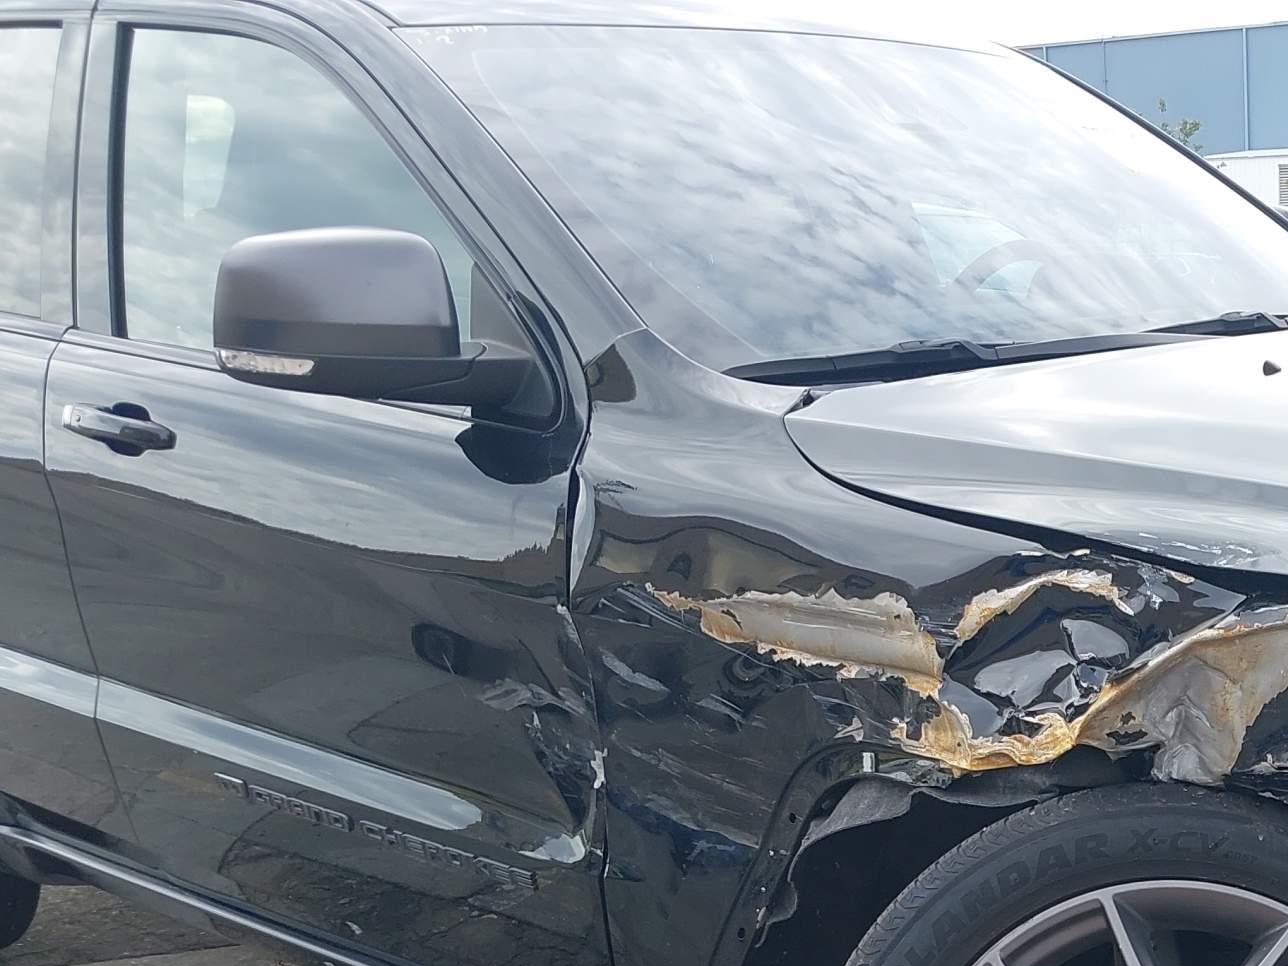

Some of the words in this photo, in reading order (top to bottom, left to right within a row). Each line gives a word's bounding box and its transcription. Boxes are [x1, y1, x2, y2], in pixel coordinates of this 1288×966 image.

[249, 784, 354, 833] GRAND
[359, 819, 538, 890] CHEROKEE
[1127, 827, 1229, 853] X-CV
